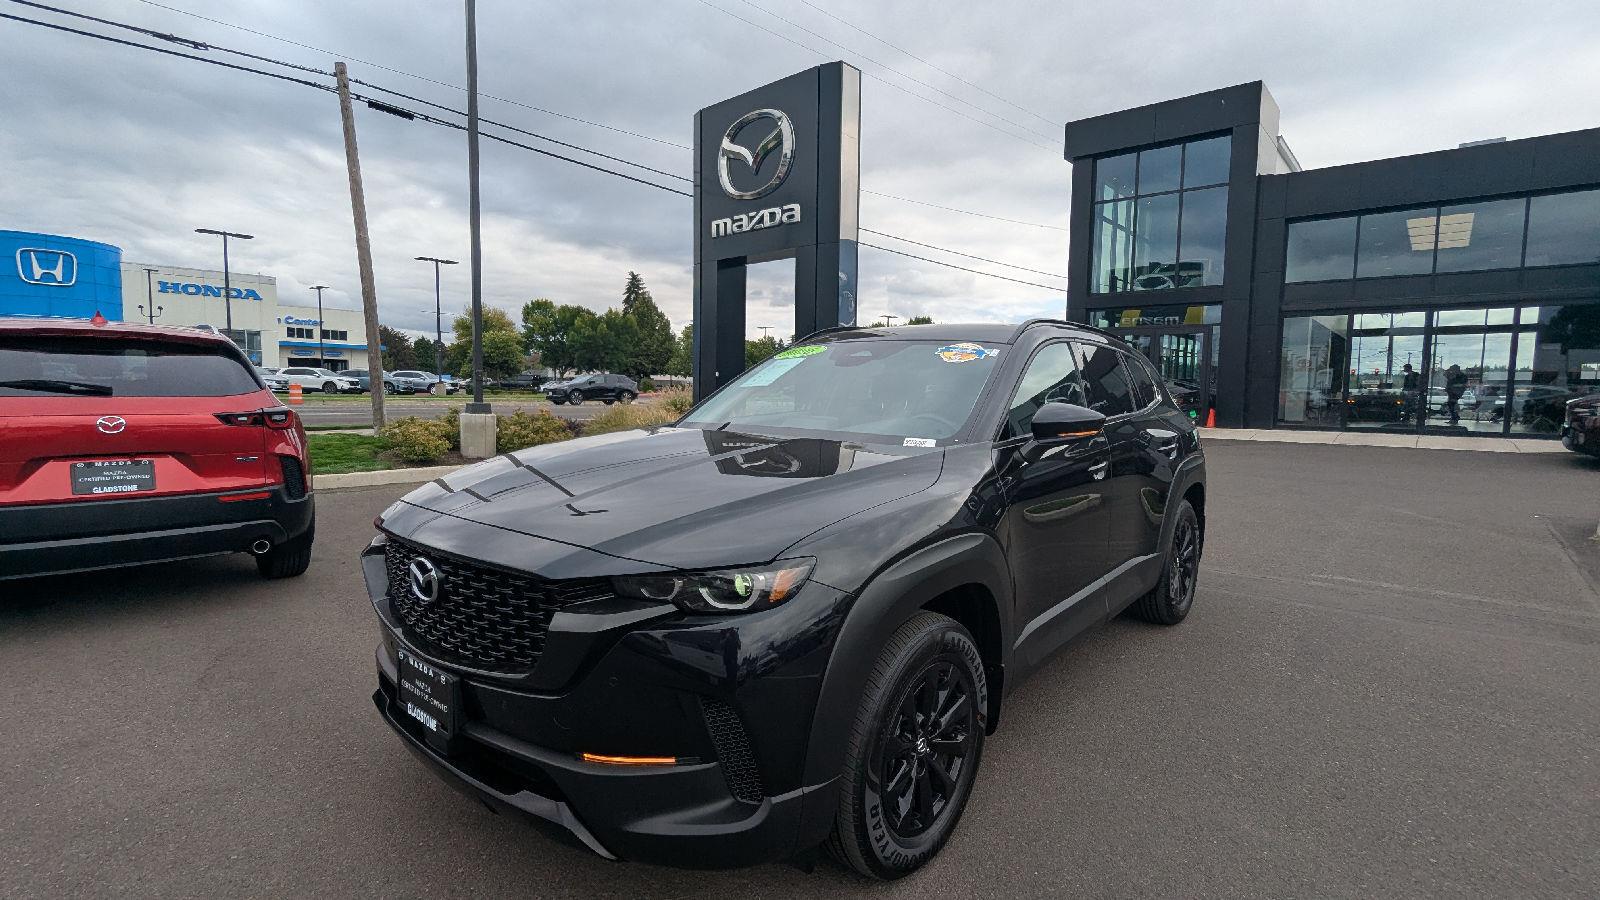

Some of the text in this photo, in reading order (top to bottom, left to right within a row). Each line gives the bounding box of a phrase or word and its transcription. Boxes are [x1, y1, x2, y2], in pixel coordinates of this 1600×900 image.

[157, 280, 263, 301] HONDA
[92, 485, 138, 494] GLADSTONE
[408, 656, 434, 678] MAZDA
[407, 702, 437, 732] GLADSTONE
